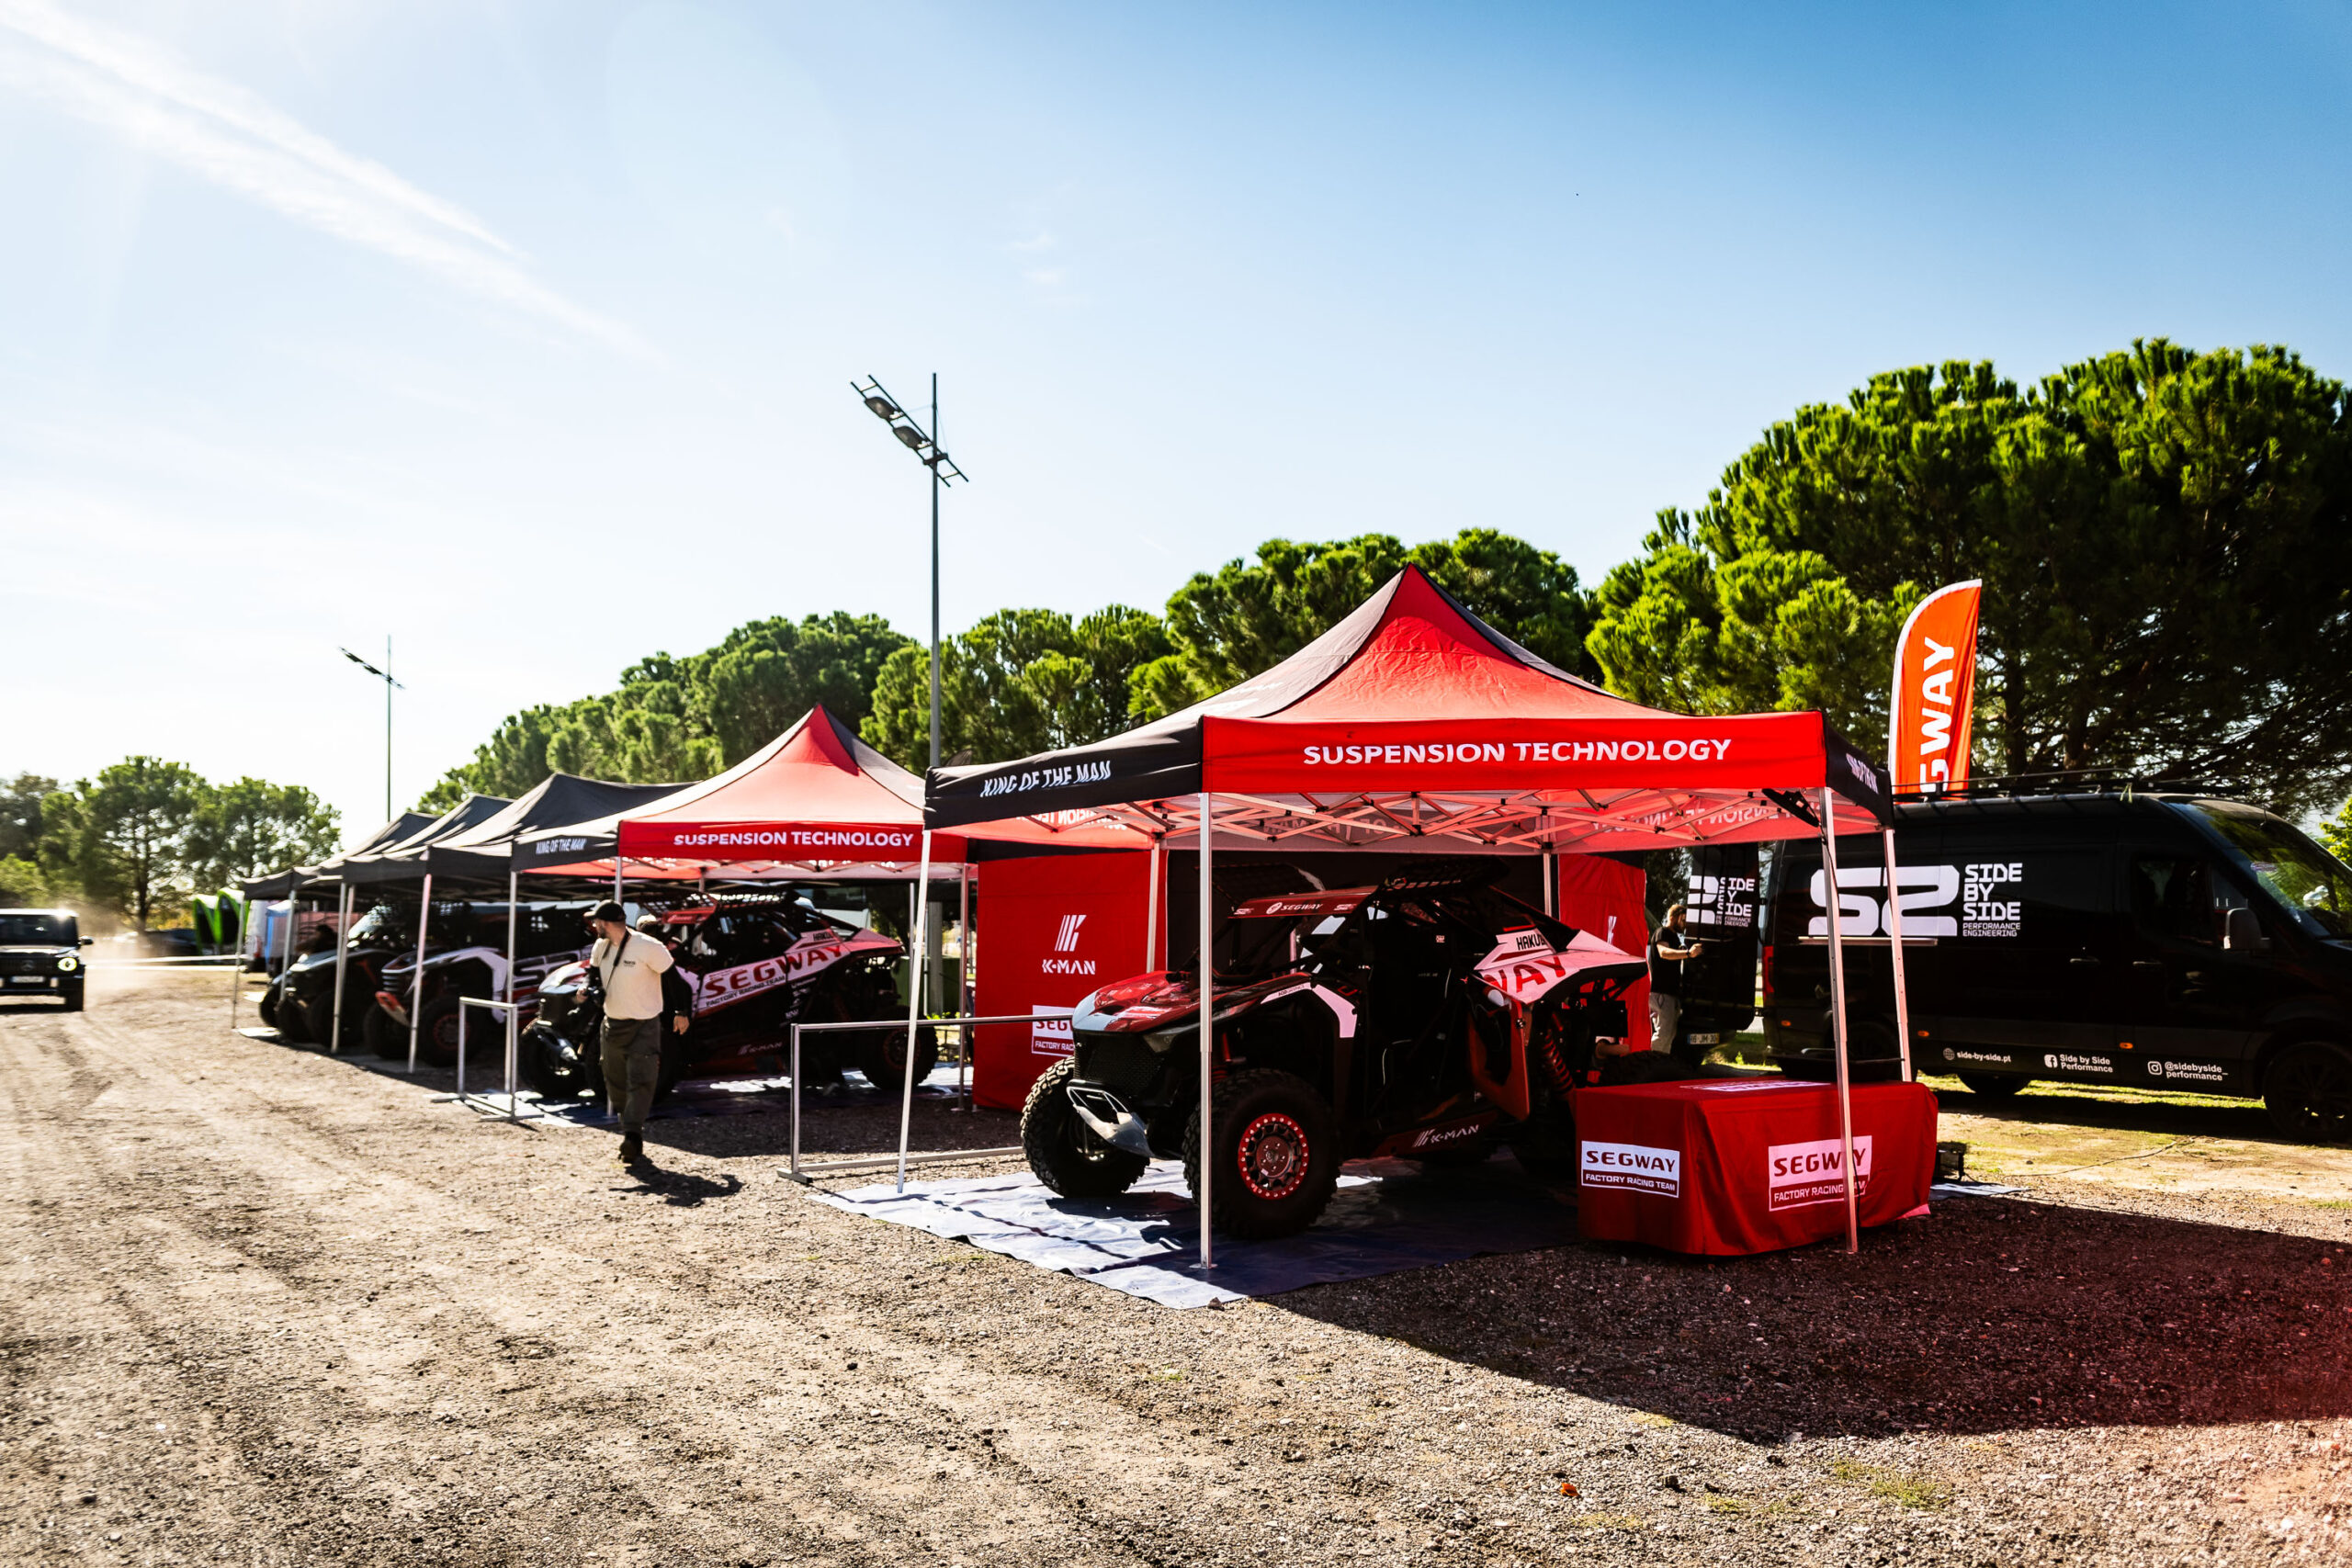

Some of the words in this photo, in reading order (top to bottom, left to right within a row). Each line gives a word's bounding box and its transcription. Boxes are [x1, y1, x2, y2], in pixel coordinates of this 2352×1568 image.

[1304, 742, 1505, 764] SUSPENSION
[1513, 739, 1732, 761] TECHNOLOGY
[979, 774, 1017, 797] KING
[1018, 772, 1039, 791] OF
[1041, 766, 1072, 787] THE
[1073, 761, 1111, 784] MAN
[673, 831, 786, 845] SUSPENSION
[791, 830, 913, 847] TECHNOLOGY
[1963, 863, 2022, 883] SIDE
[1963, 883, 1995, 902] BY
[1280, 903, 1324, 911] SEGWAY
[1962, 902, 2021, 921] SIDE
[705, 944, 842, 999] SEGWAY
[1035, 1040, 1061, 1050] FACTORY
[1061, 1043, 1075, 1052] RAC
[1957, 1051, 2011, 1064] side-by-side.pt
[2059, 1054, 2077, 1063] Side
[2079, 1055, 2090, 1065] by
[2091, 1055, 2111, 1066] Side
[2061, 1062, 2113, 1073] Performance
[2165, 1070, 2223, 1081] performance
[1586, 1150, 1675, 1172] SEGWAY
[1773, 1147, 1866, 1177] SEGWY
[1585, 1173, 1625, 1183] FACTORY
[1626, 1177, 1655, 1188] RACING
[1656, 1181, 1676, 1191] TEAM
[1774, 1188, 1810, 1202] FACTORY
[1811, 1183, 1844, 1196] RACING
